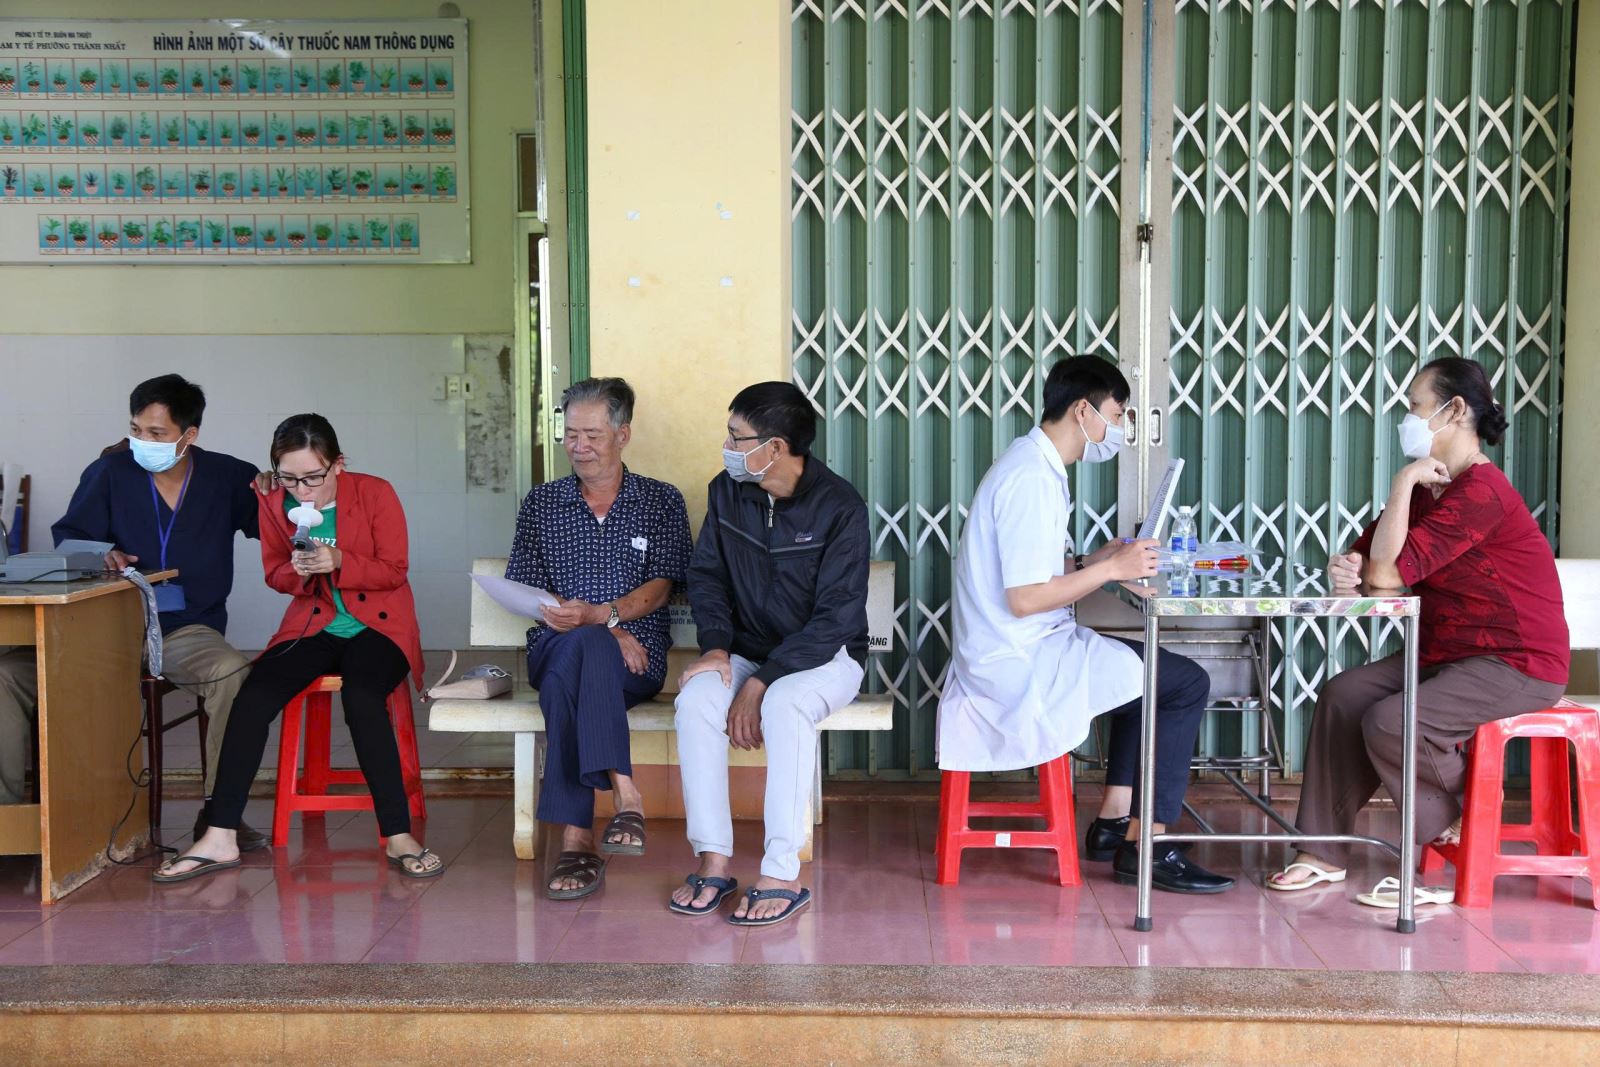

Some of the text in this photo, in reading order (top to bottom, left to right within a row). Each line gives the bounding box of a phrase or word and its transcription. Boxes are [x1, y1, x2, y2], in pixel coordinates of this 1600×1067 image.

[23, 39, 34, 49] TẾ
[103, 39, 126, 50] NHẤT
[153, 30, 454, 53] HÌNH ẢNH MỘT SỐ CÂY THUỐC NAM THÔNG DỤNG
